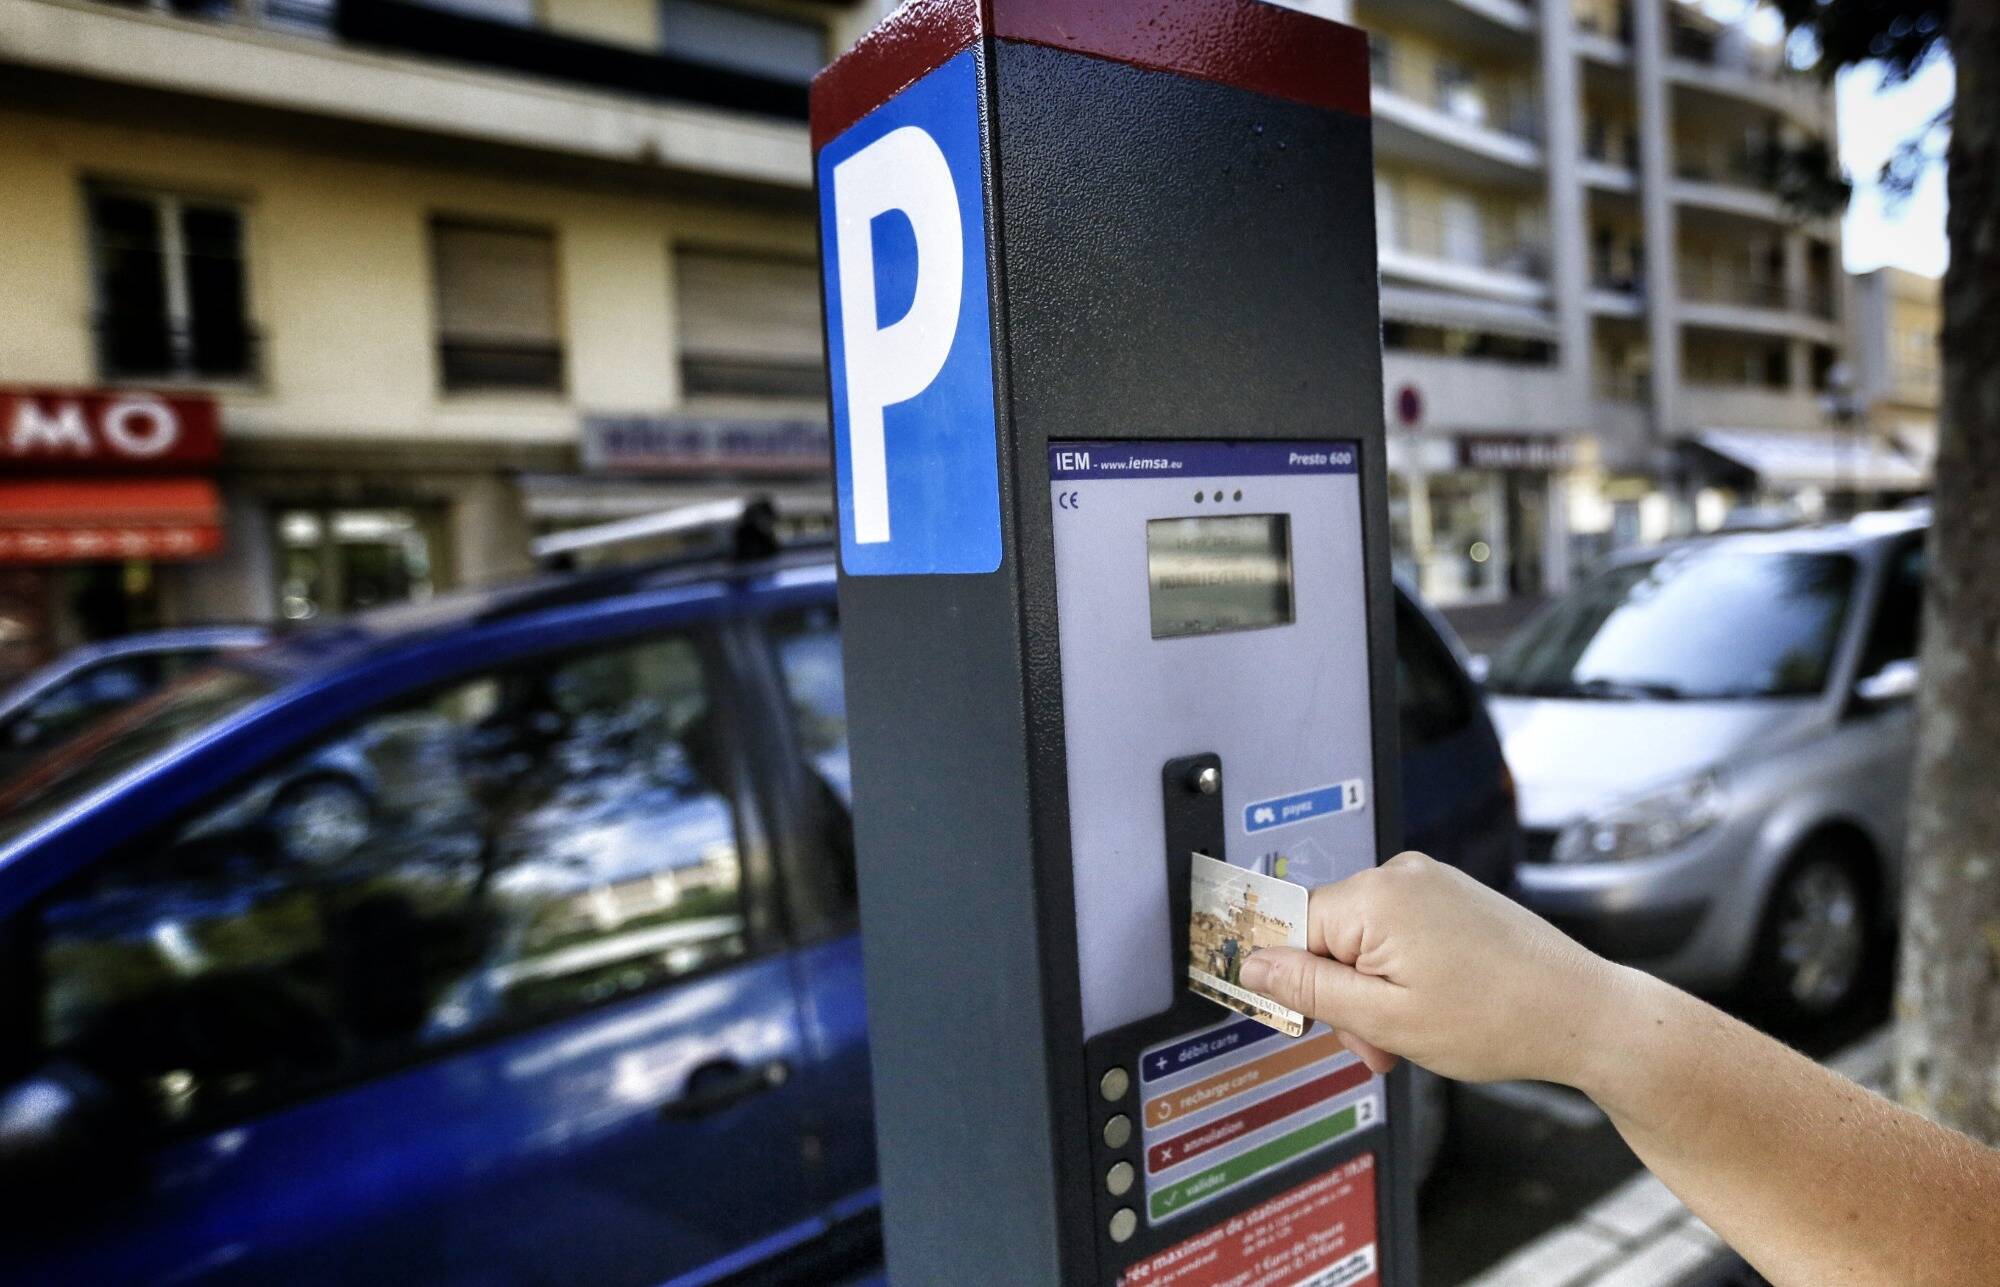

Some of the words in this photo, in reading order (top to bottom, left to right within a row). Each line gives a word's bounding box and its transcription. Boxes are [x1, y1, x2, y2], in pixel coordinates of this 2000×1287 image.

[834, 126, 963, 544] P
[1056, 452, 1090, 471] IEM
[1100, 456, 1183, 470] www.iemsa.eu
[1289, 452, 1327, 466] Presto
[1330, 452, 1352, 466] 600
[1349, 785, 1358, 804] 1
[1178, 1042, 1209, 1062] débit
[1210, 1033, 1239, 1050] carte
[1181, 1082, 1230, 1107] recharge
[1231, 1070, 1259, 1088] carte
[1360, 1102, 1373, 1121] 2
[1183, 1121, 1244, 1153] annulation
[1153, 1229, 1224, 1271] maximum
[1226, 1217, 1244, 1235] de
